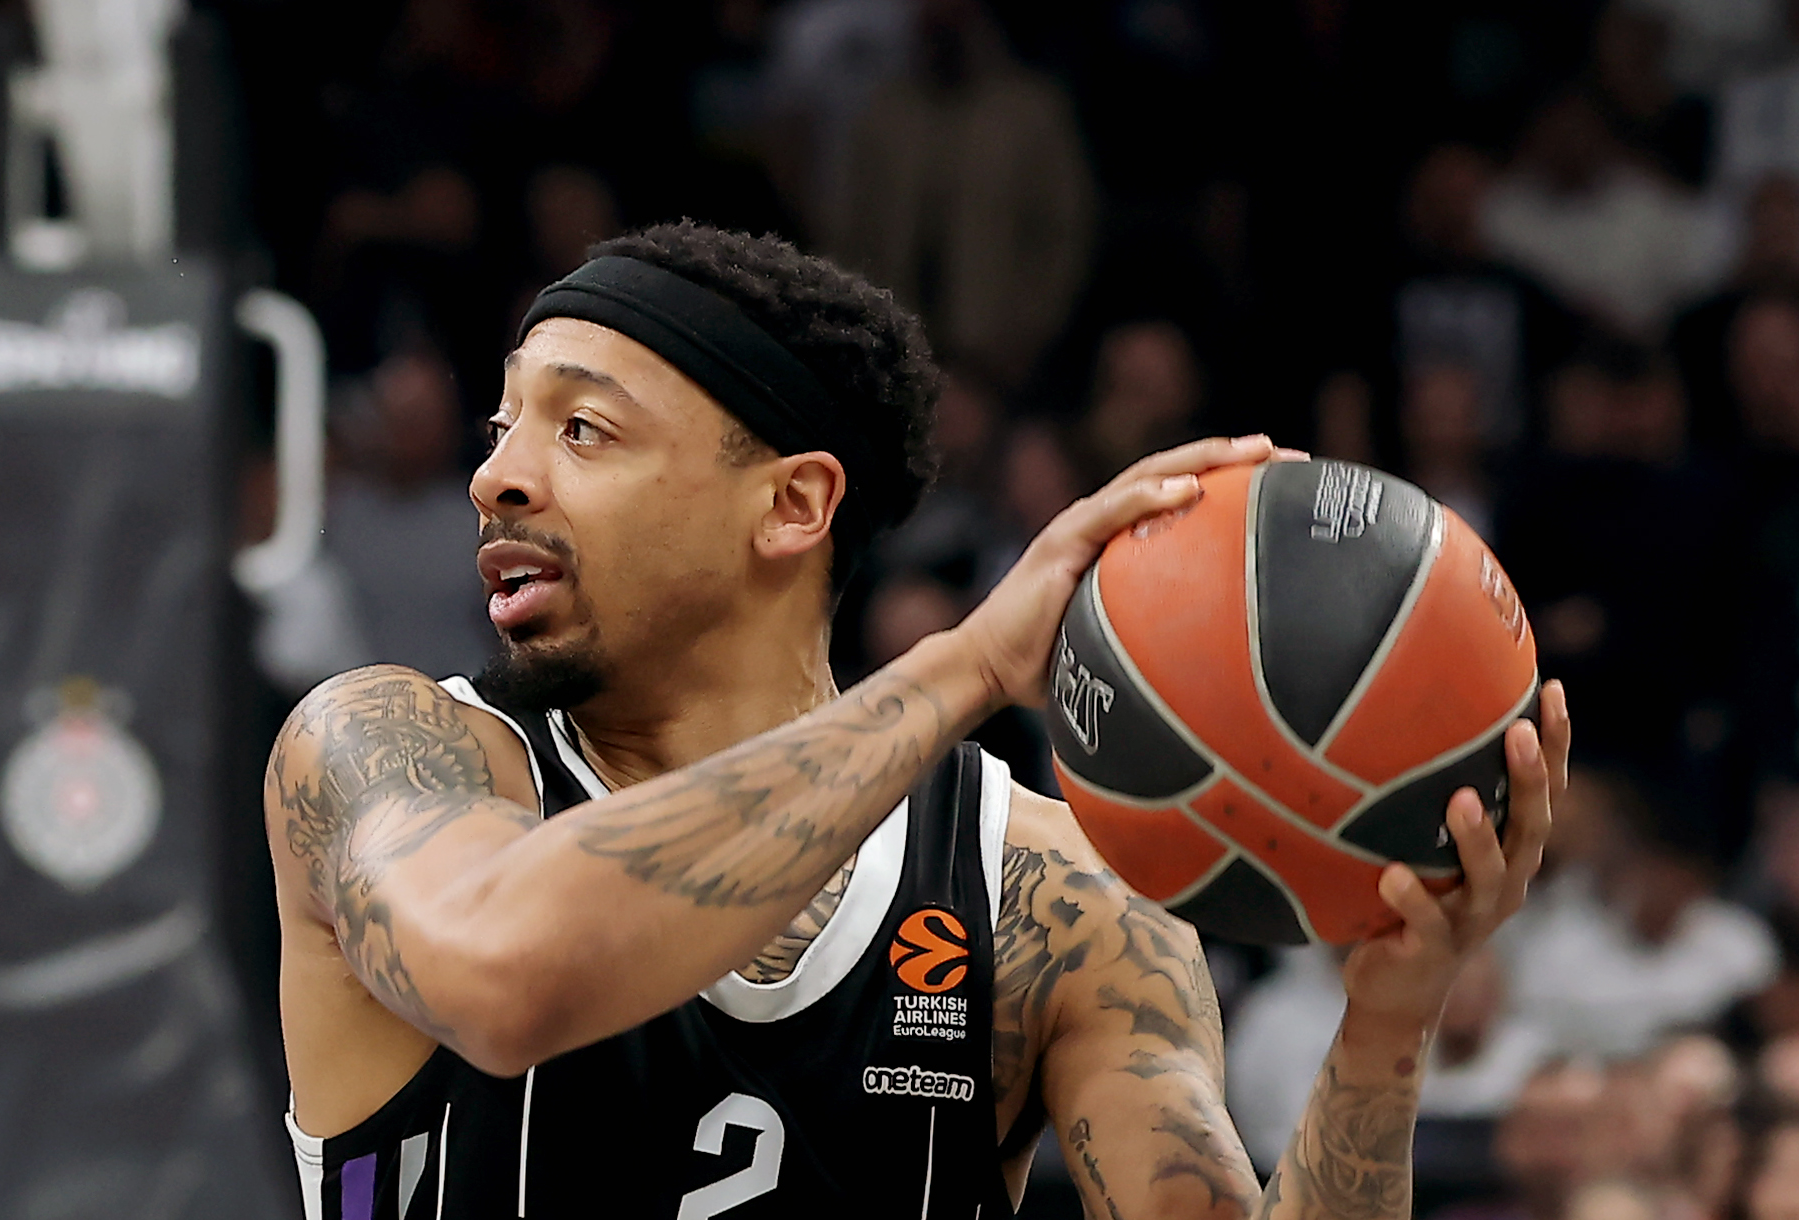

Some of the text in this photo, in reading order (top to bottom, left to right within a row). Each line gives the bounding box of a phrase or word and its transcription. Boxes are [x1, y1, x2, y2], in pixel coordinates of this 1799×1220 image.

[893, 995, 967, 1012] TURKISH
[893, 1010, 967, 1026] AIRLINES
[893, 1024, 966, 1041] EuroLeague
[863, 1065, 975, 1102] oneteam
